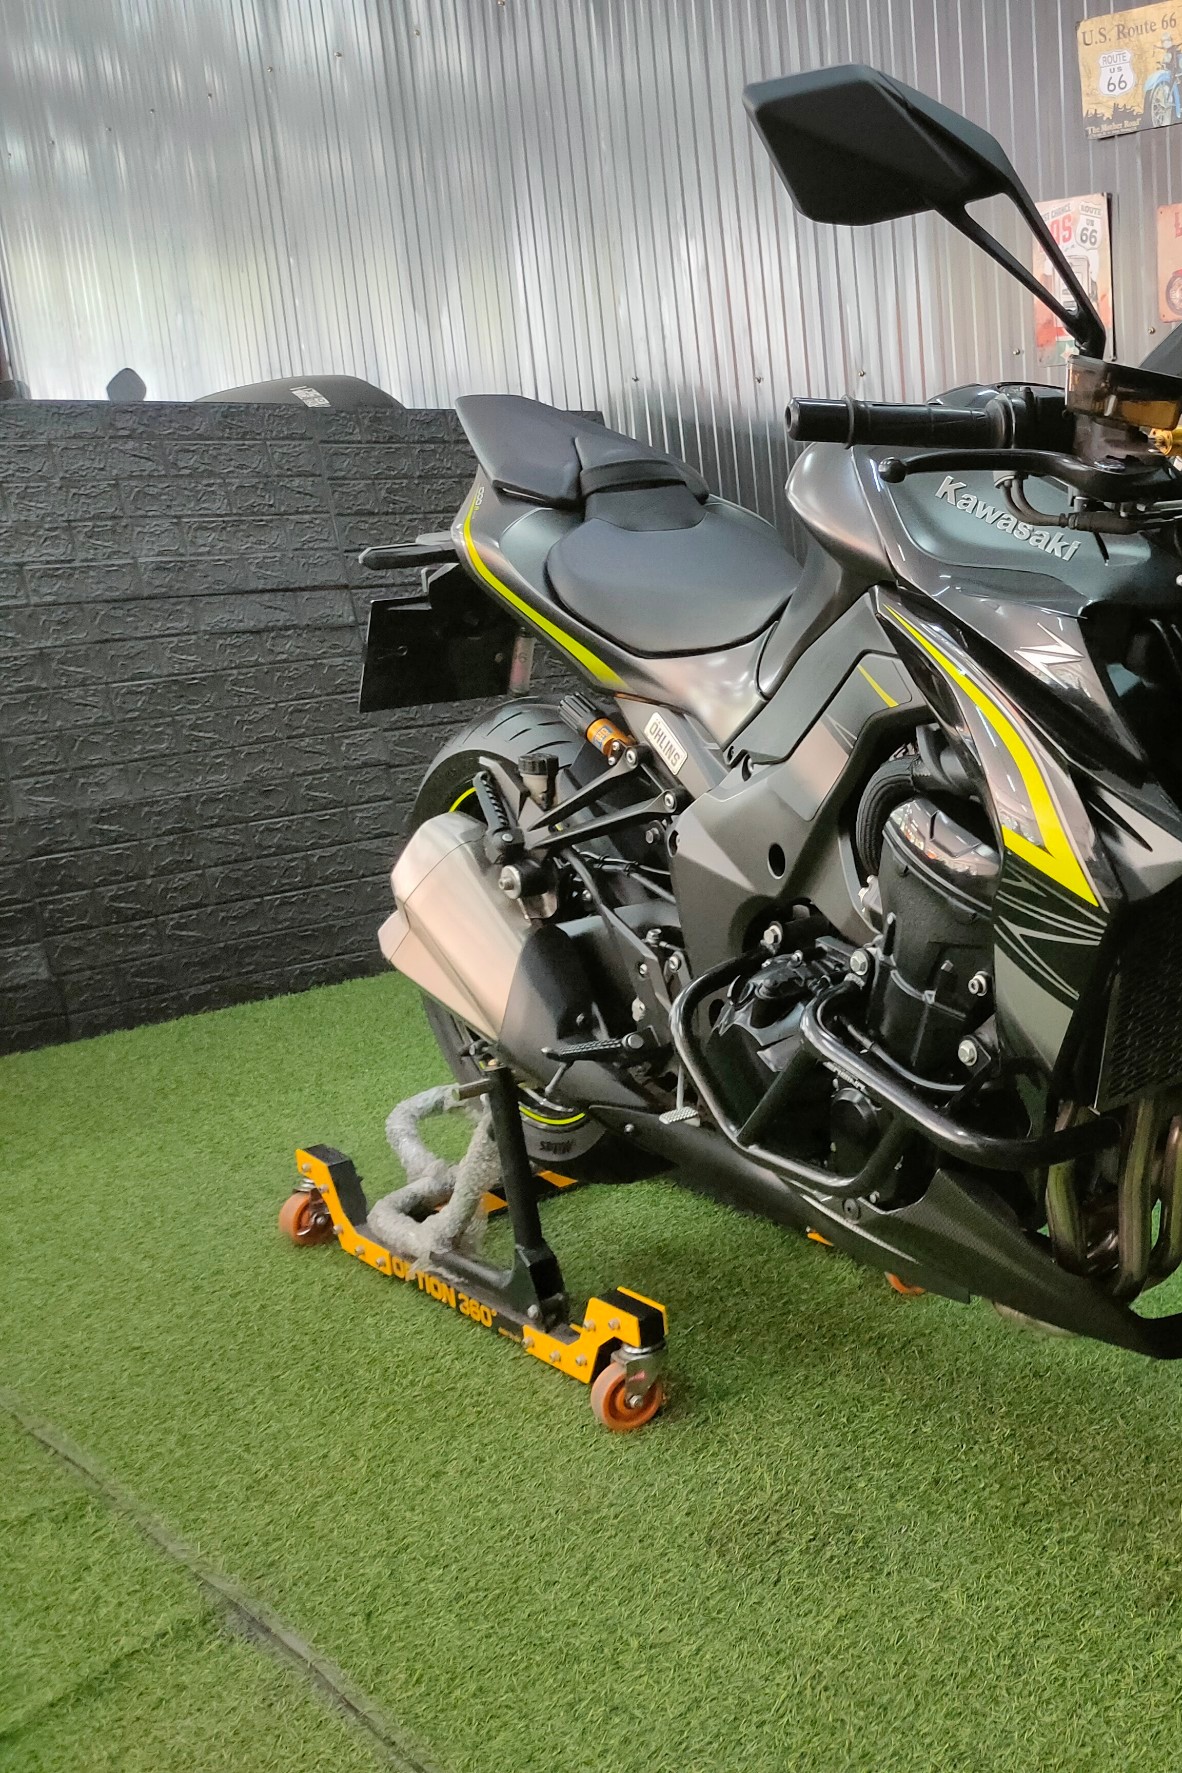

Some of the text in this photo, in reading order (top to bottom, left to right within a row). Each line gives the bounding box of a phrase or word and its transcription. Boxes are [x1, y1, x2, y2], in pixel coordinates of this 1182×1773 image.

[1082, 12, 1177, 46] U.S. Route 66
[1102, 52, 1127, 65] ROUTE
[1107, 74, 1128, 92] 66
[1080, 205, 1102, 216] ROUTE
[1080, 227, 1098, 246] 66
[934, 475, 1082, 562] Kawasaki
